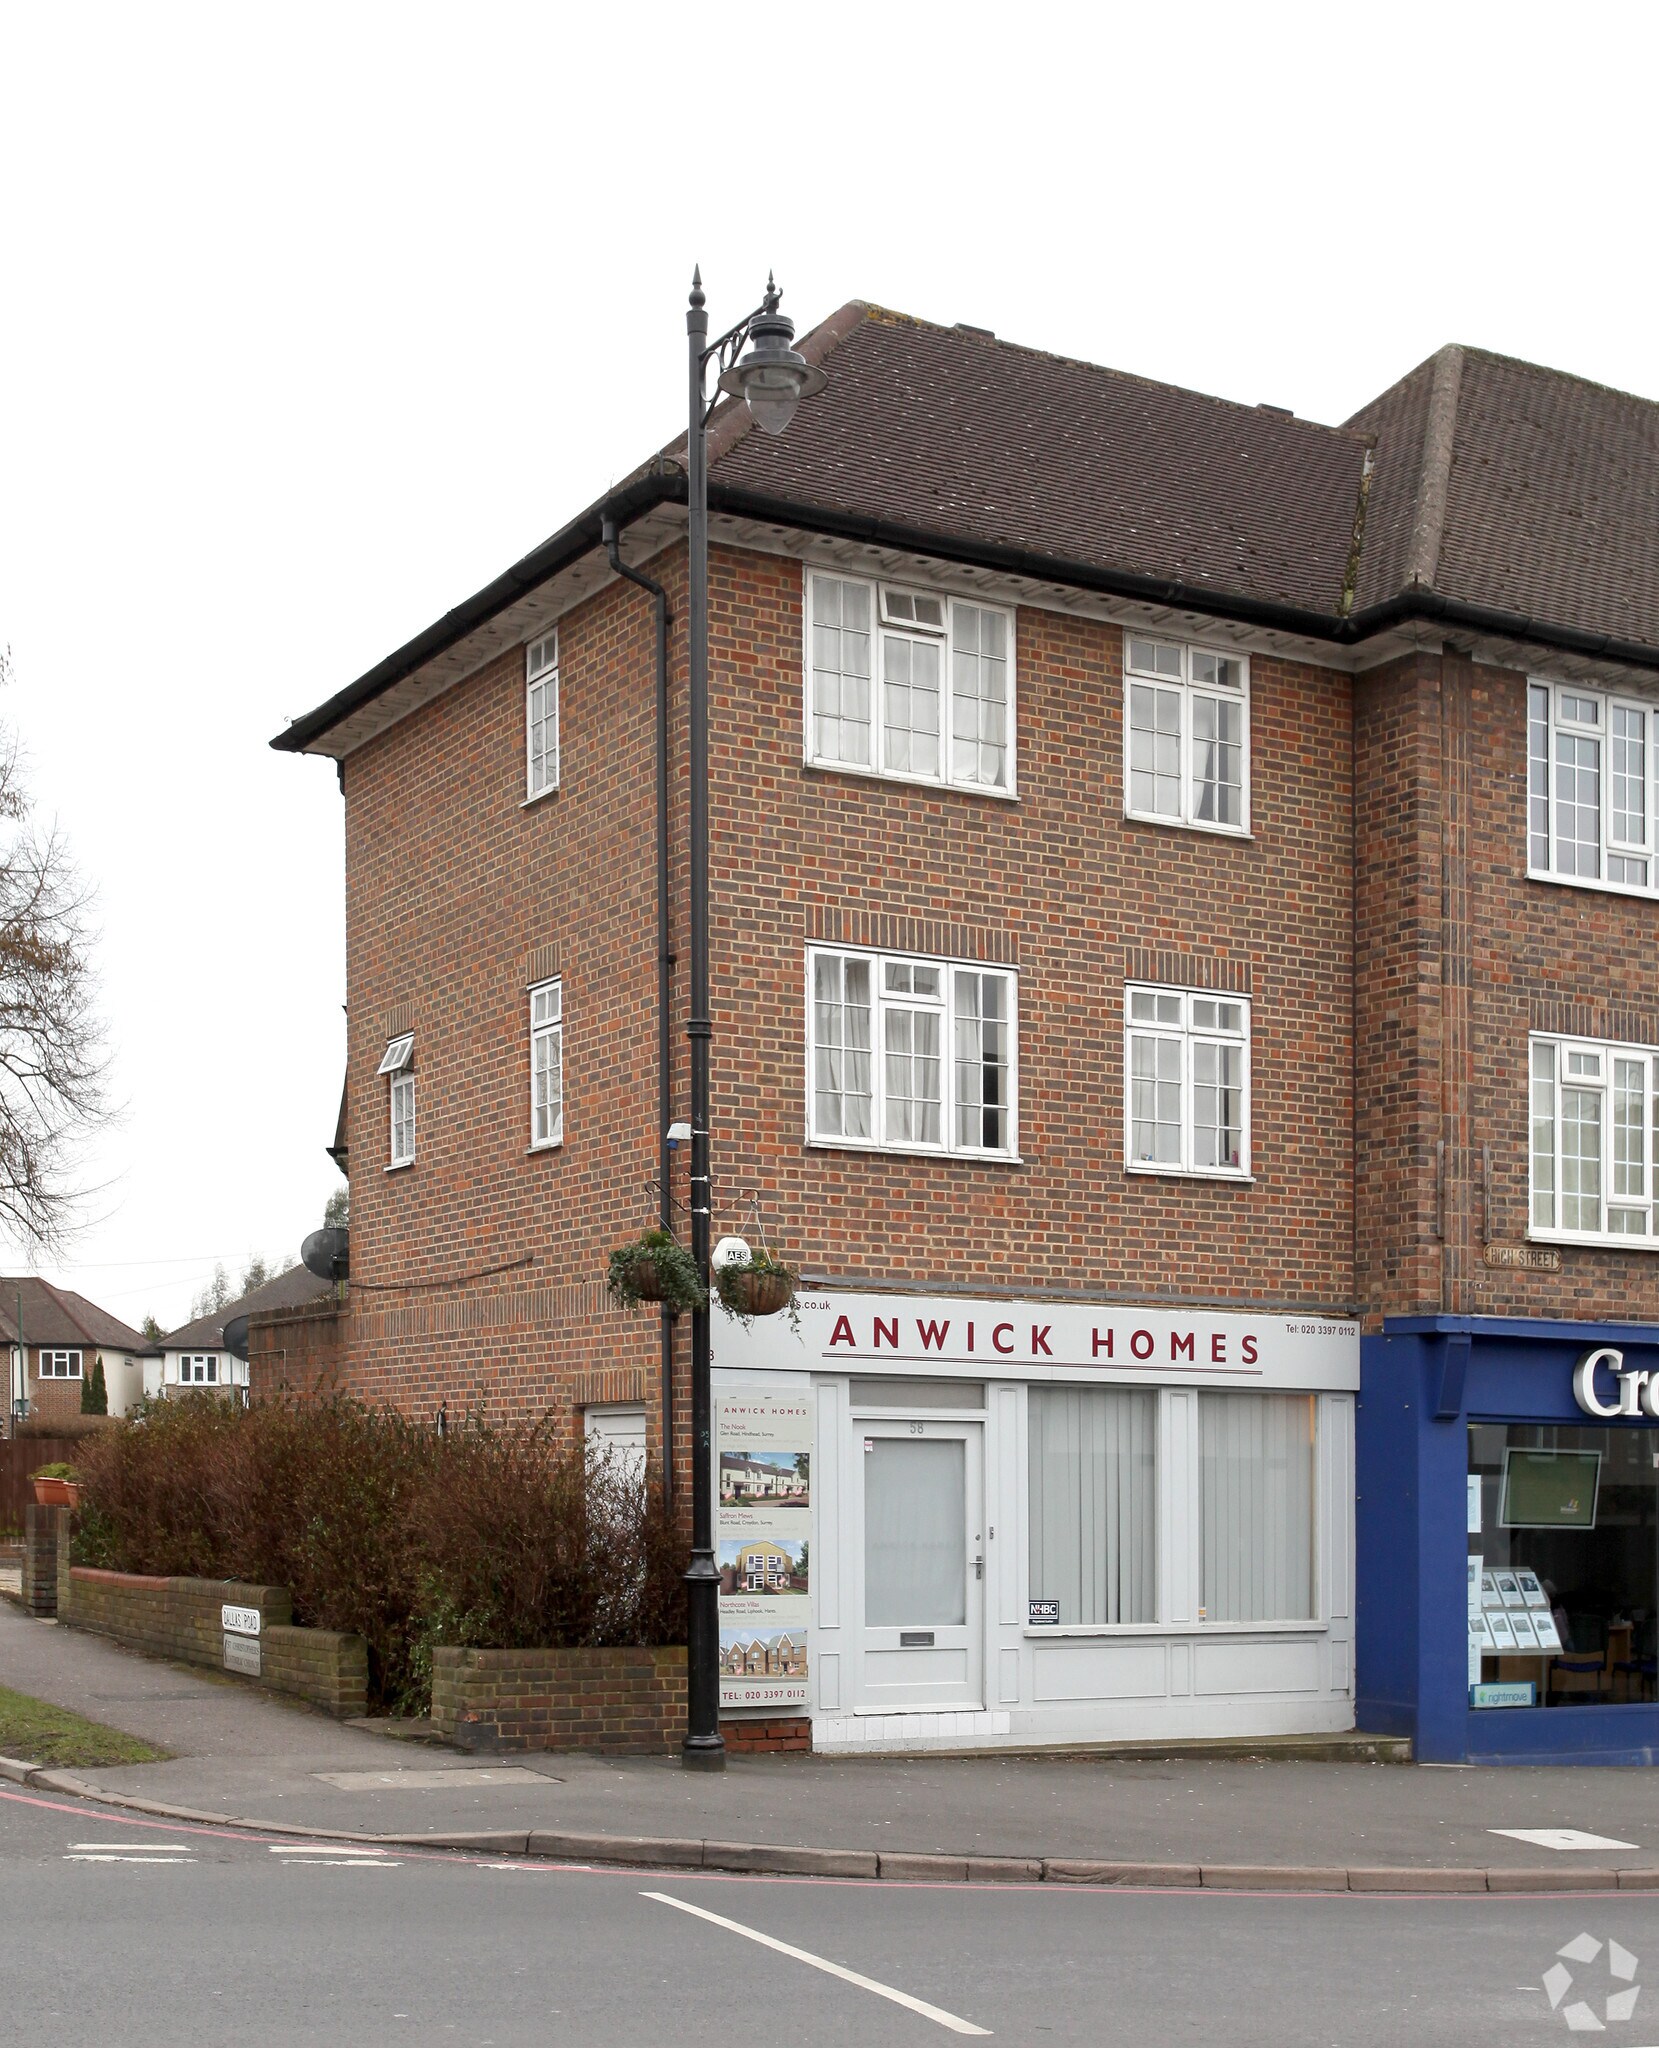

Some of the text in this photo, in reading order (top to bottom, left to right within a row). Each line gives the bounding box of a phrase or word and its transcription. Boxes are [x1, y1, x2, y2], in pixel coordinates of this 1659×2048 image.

[728, 1251, 747, 1260] AES
[1491, 1248, 1556, 1267] HIGH STREET
[1286, 1324, 1356, 1336] Tel: 020 3397 0112
[829, 1315, 1258, 1364] ANWICK HOMES
[724, 1407, 807, 1416] ANWICK HOMES
[910, 1421, 924, 1434] 58
[1030, 1604, 1056, 1614] NHBC
[722, 1690, 805, 1700] TEL: 020 3397 0112
